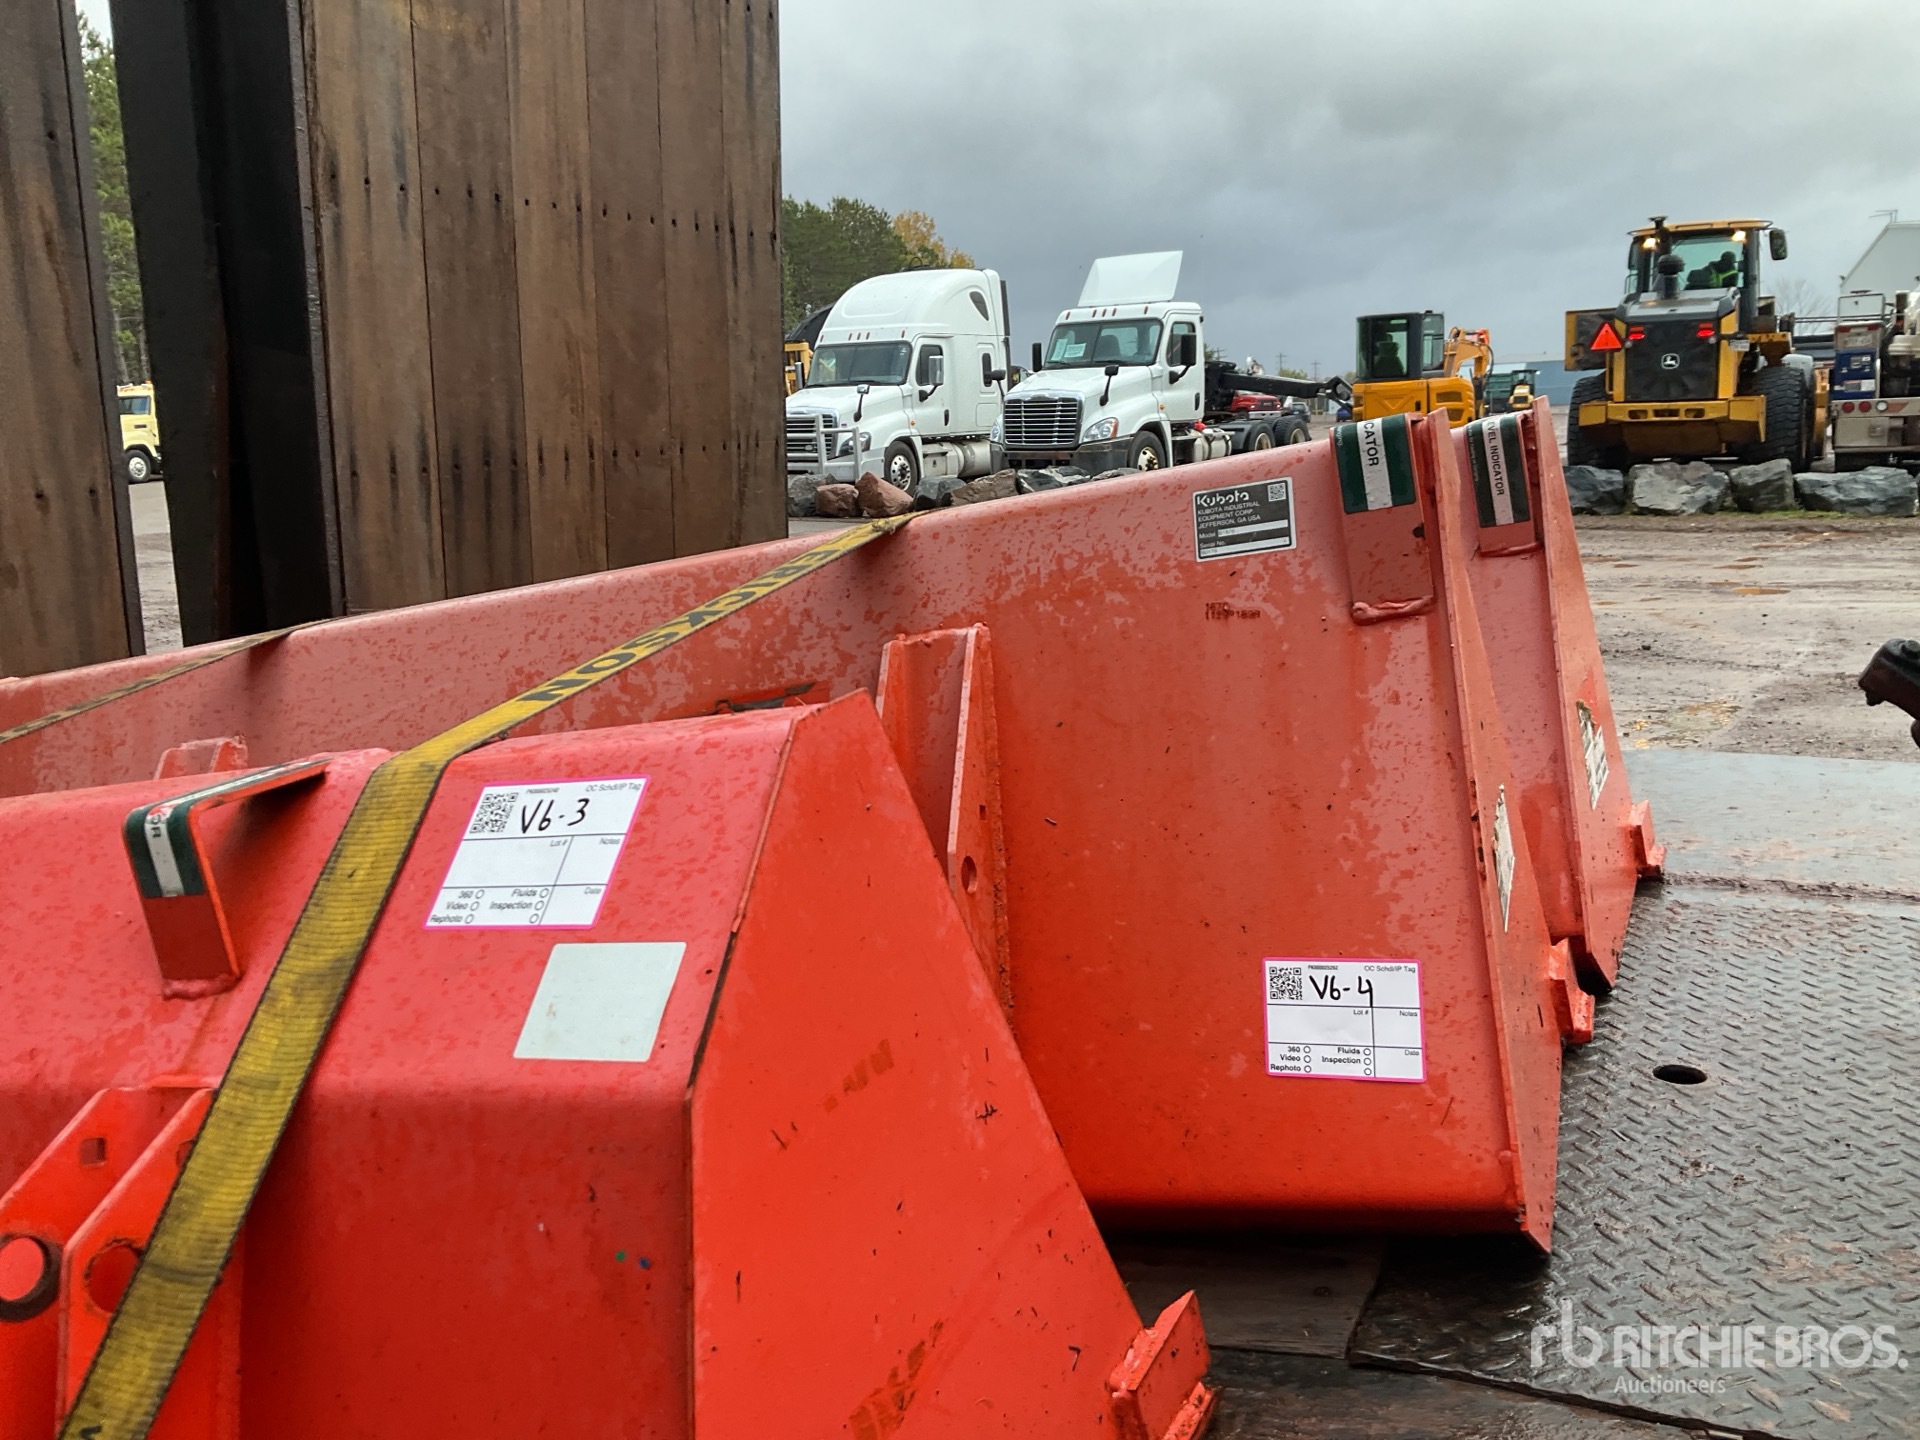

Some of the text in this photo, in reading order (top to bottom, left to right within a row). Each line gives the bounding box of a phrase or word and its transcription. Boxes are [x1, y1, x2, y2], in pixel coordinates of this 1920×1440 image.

[1363, 422, 1379, 467] CATOR
[1487, 421, 1505, 496] EVEL INDICATOR
[1197, 490, 1250, 507] Kubota
[1197, 501, 1260, 515] KUBOTA INDUSTRIAL
[1198, 511, 1234, 523] EQUIPMENT
[517, 548, 840, 702] ERICKSON
[628, 782, 642, 791] Tag
[550, 839, 561, 847] Lot
[599, 837, 620, 845] Notes
[458, 890, 474, 899] 360
[511, 889, 538, 897] Fluids
[584, 887, 602, 895] Date
[446, 902, 469, 910] Video
[489, 901, 533, 911] Inspection
[430, 914, 462, 924] Rephoto
[1321, 1056, 1361, 1065] Inspection
[1270, 1064, 1301, 1072] Rephoto
